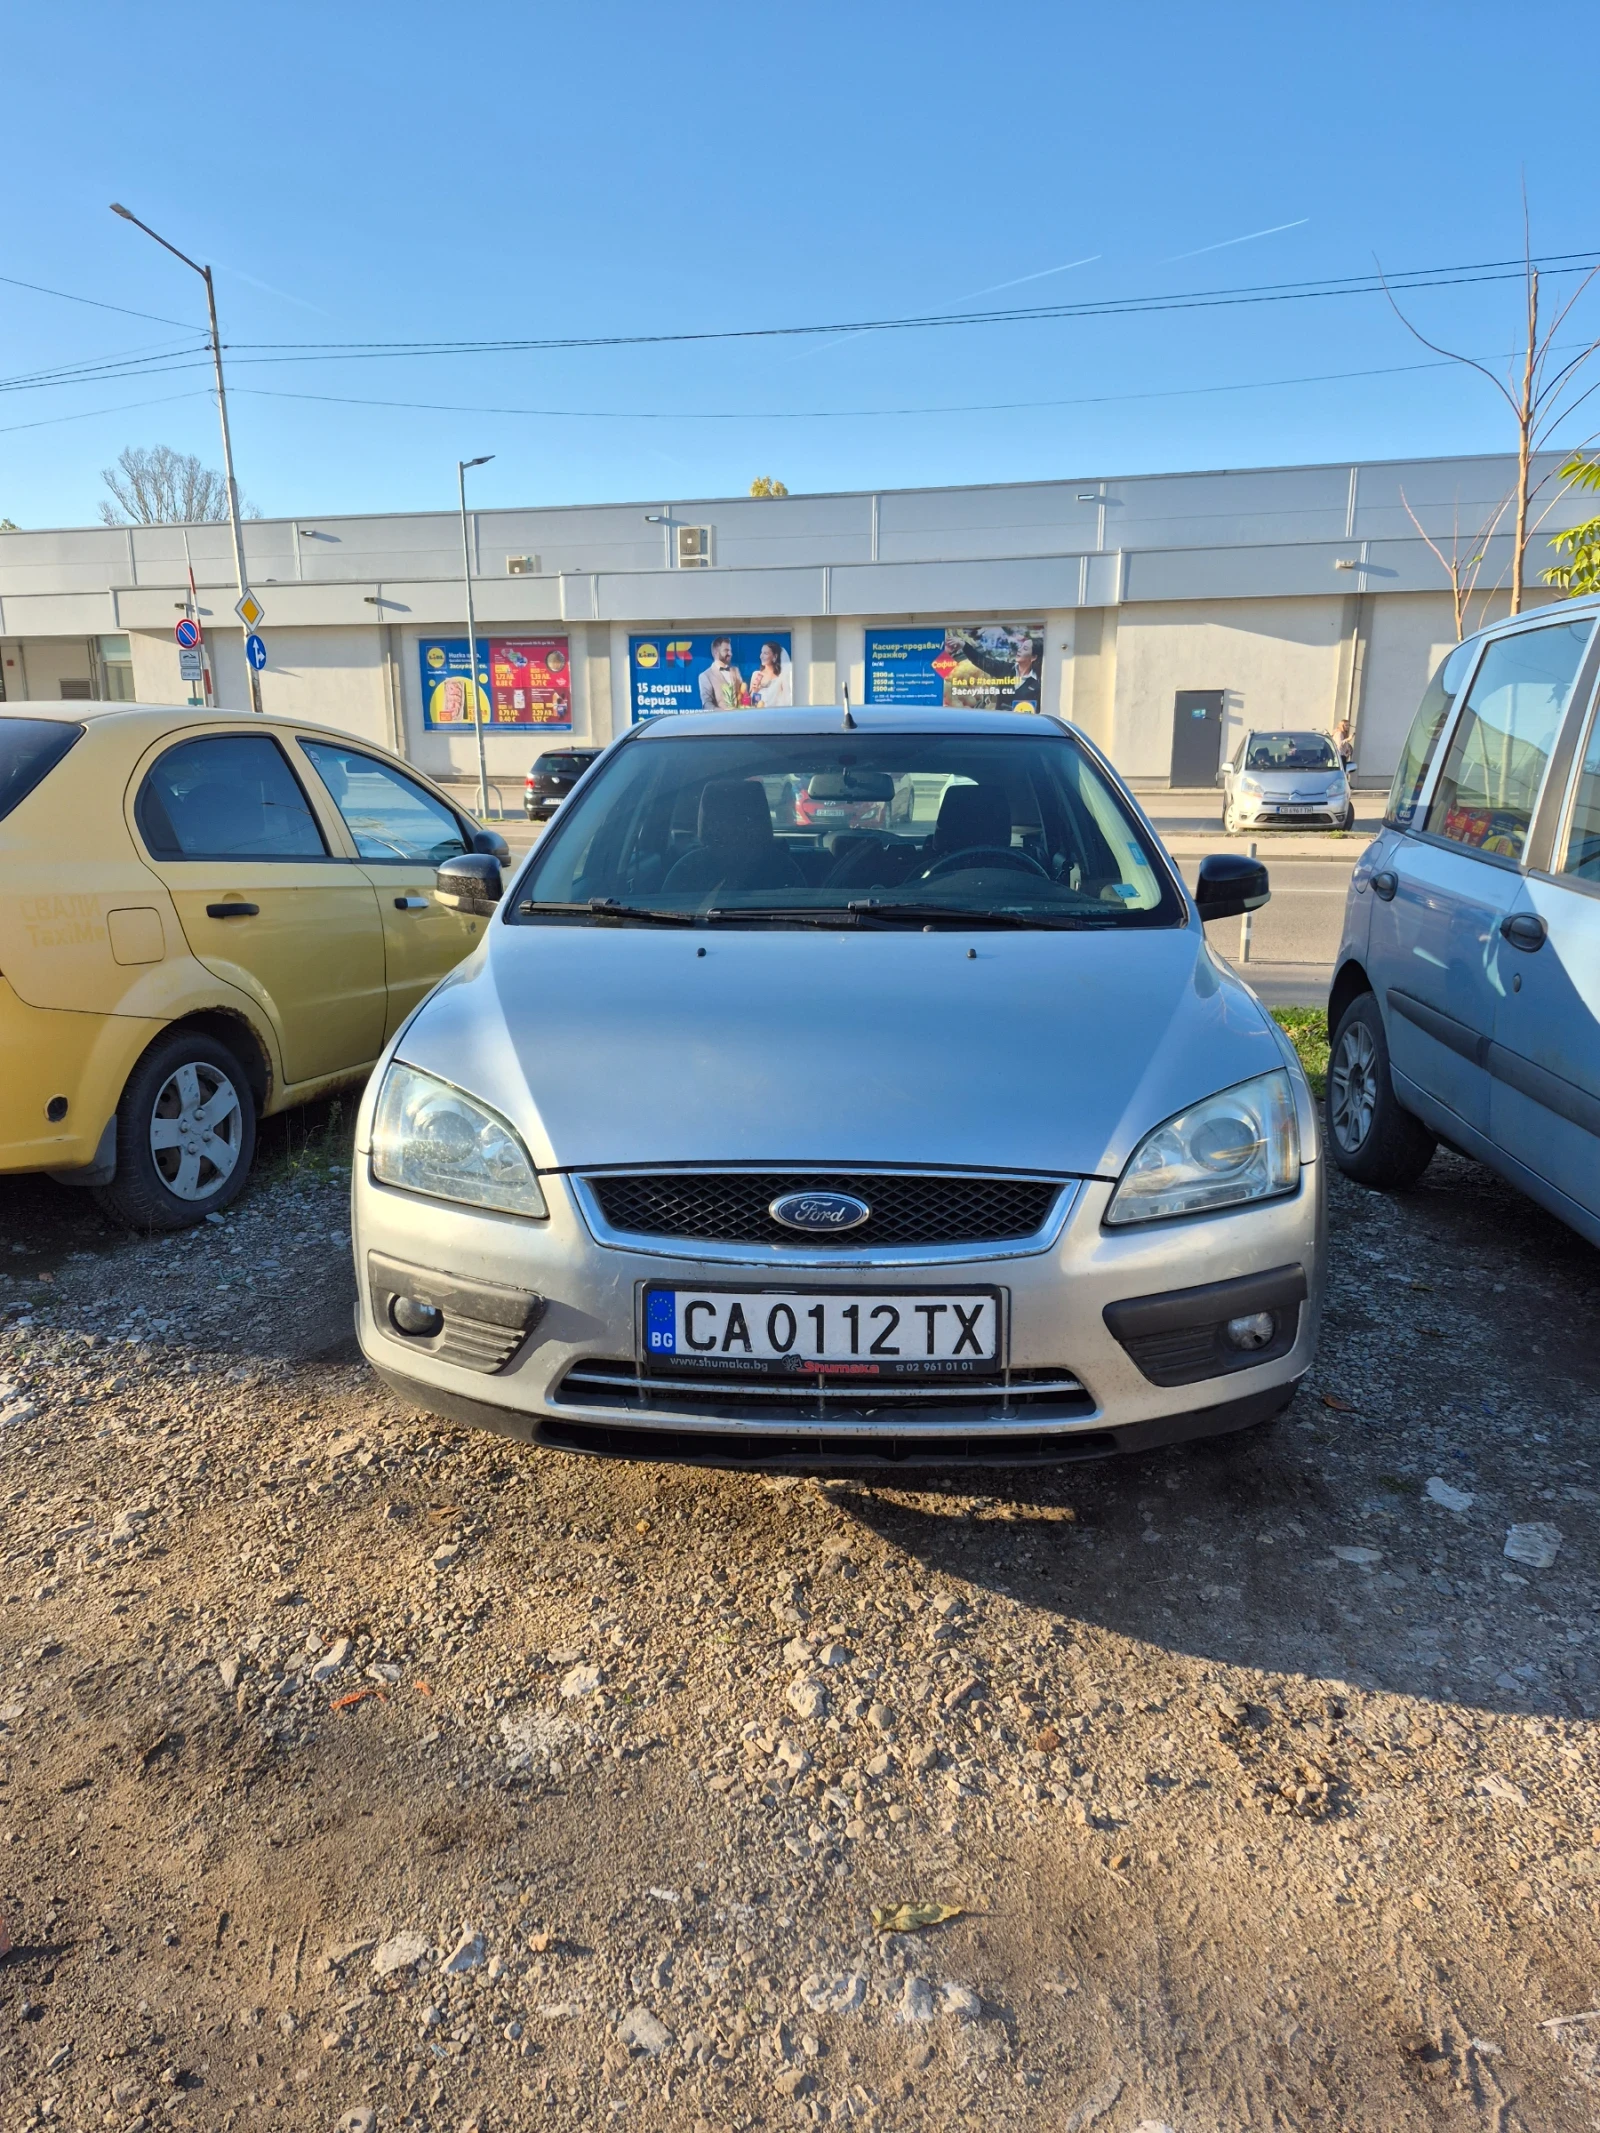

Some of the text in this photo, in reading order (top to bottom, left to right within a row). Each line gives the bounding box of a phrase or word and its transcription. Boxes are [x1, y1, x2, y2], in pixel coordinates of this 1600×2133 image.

[872, 651, 908, 660] Аранжор
[931, 661, 958, 669] София
[952, 677, 967, 686] Ела
[969, 677, 975, 685] в
[637, 682, 692, 696] 15 години
[951, 687, 1000, 696] Заслужава
[637, 694, 677, 708] верига
[795, 1200, 846, 1222] Ford
[651, 1332, 673, 1348] BG
[670, 1357, 768, 1372] www.shumaka.bg
[799, 1360, 880, 1374] Shumaka
[906, 1361, 974, 1372] 02 961 01 01
